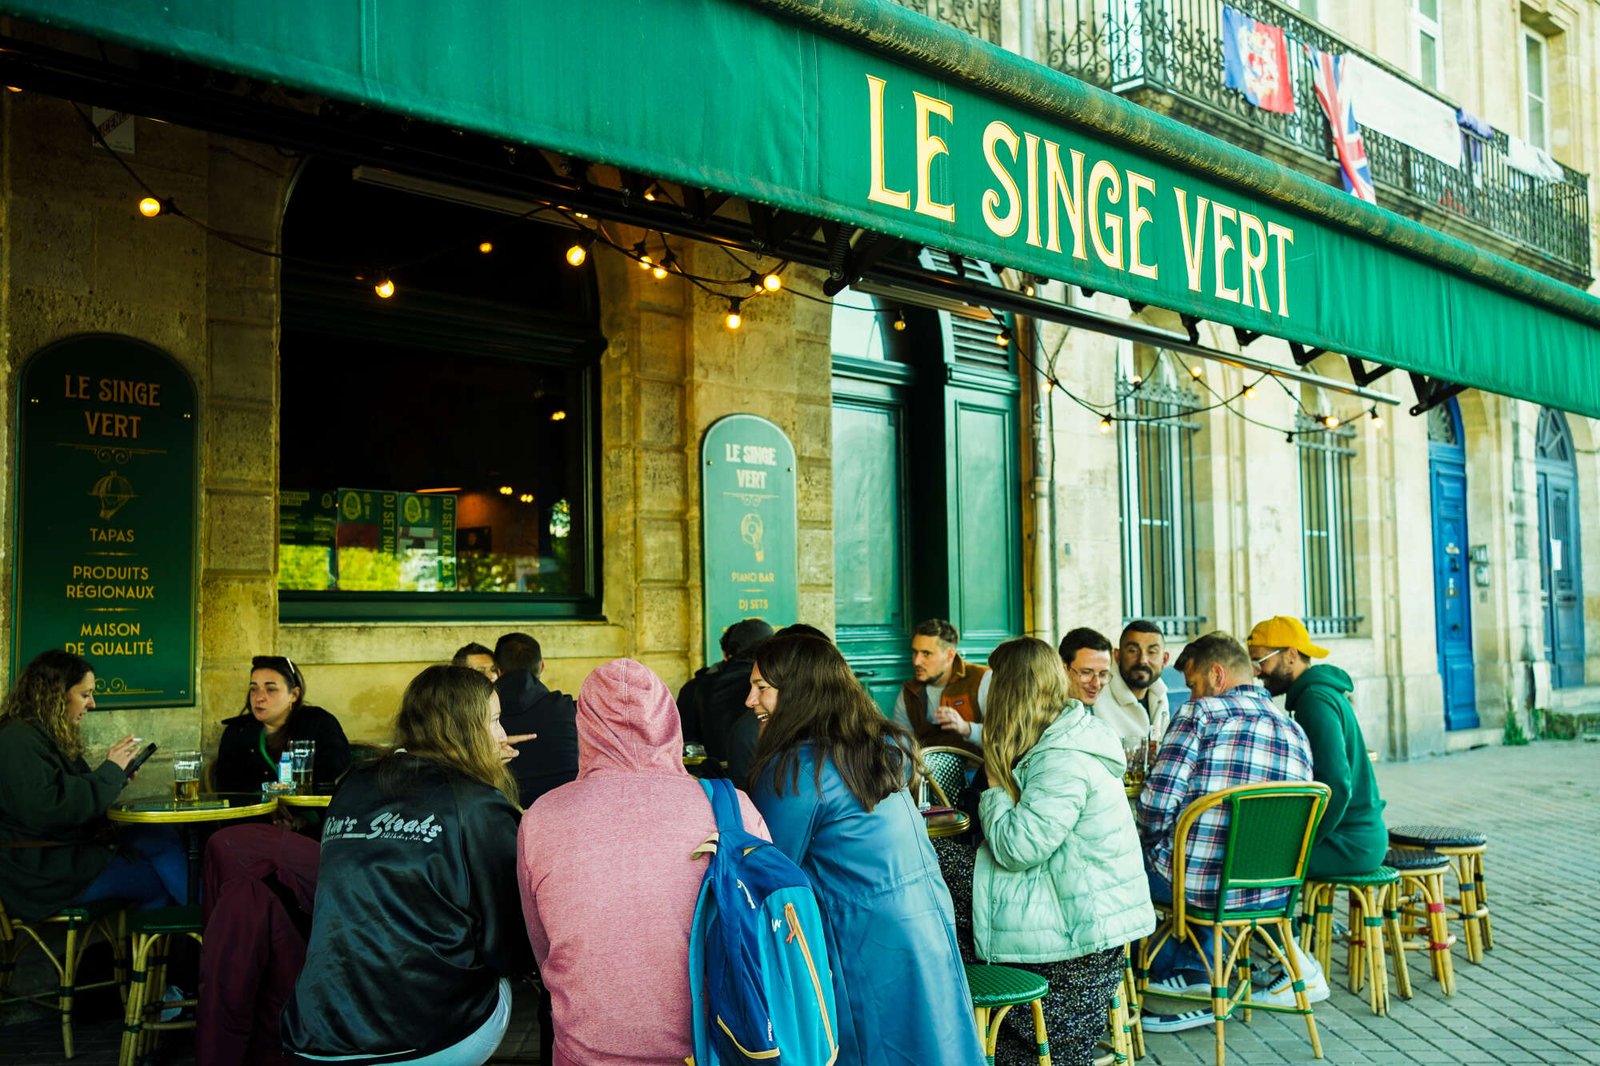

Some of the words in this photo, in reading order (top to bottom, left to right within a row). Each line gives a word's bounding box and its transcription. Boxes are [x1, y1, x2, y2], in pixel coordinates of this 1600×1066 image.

[865, 73, 956, 223] LE
[981, 120, 1159, 281] SINGE
[1173, 186, 1294, 318] VERT
[65, 374, 91, 399] LE
[99, 378, 161, 407] SINGE
[84, 411, 142, 439] VERT
[726, 444, 740, 462] LE
[743, 446, 777, 466] SINGE
[736, 469, 767, 489] VERT
[383, 494, 395, 508] DJ
[442, 498, 453, 510] DJ
[383, 512, 395, 532] SET
[441, 513, 453, 531] SET
[90, 528, 135, 544] TAPAS
[73, 566, 149, 581] PRODUITS
[731, 571, 757, 583] PIANO
[758, 572, 775, 583] BAR
[66, 581, 155, 599] RÉGIONAUX
[738, 599, 748, 610] DJ
[750, 599, 768, 610] SETS
[80, 623, 141, 637] MAISON
[65, 642, 85, 656] DE
[91, 638, 154, 656] QUALITÉ
